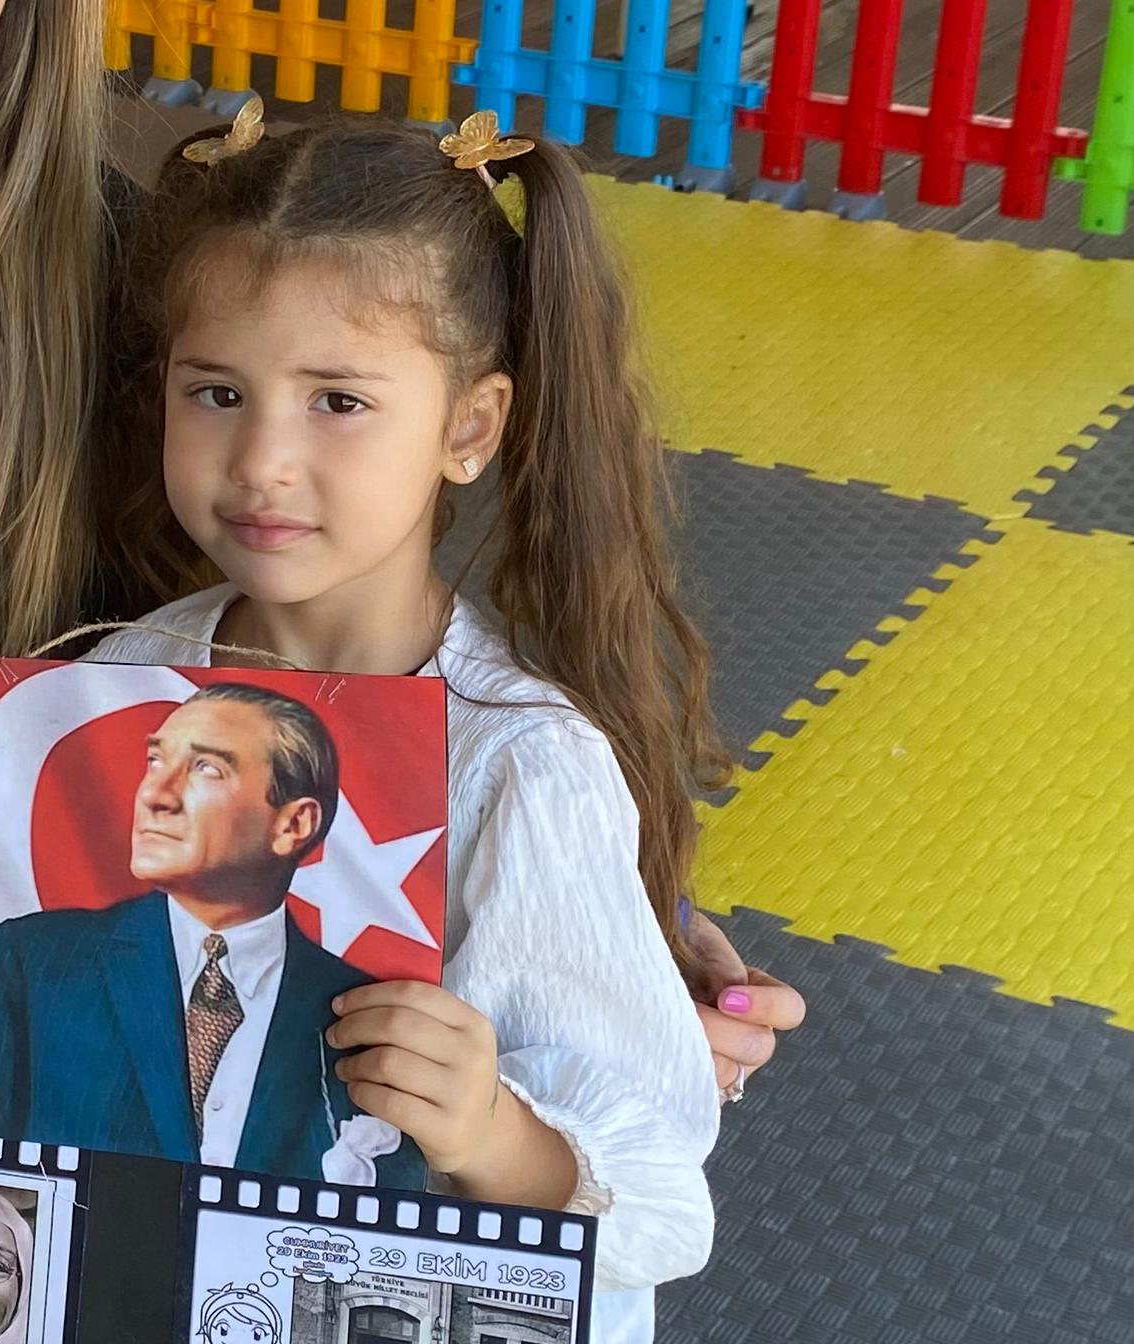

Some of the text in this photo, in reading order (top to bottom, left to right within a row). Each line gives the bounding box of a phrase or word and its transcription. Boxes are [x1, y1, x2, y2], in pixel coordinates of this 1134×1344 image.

[321, 1252, 349, 1264] 1923
[368, 1246, 567, 1292] 29 EKİM 1923
[371, 1275, 405, 1288] TÜRKİYE
